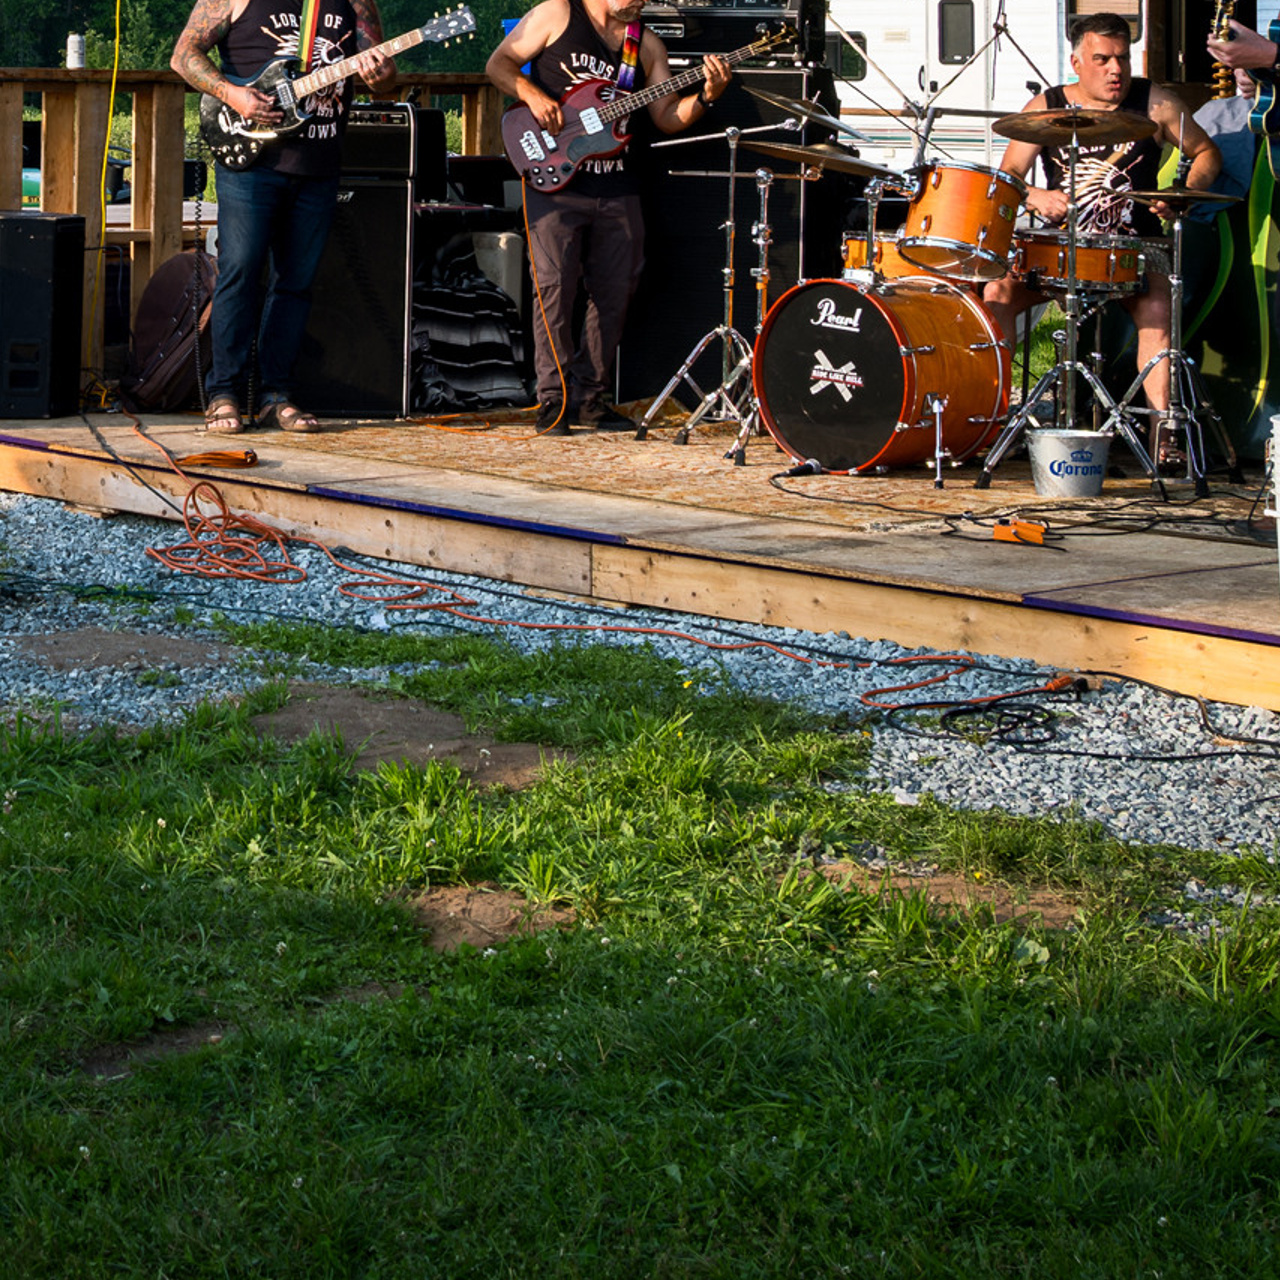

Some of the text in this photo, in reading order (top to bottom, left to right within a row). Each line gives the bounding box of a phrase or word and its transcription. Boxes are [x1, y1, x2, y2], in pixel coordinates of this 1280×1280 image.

[269, 12, 343, 30] LOR OF
[570, 52, 615, 78] LORDS
[299, 122, 337, 139] OWN
[588, 158, 625, 175] TOWN
[810, 298, 863, 329] Pearl
